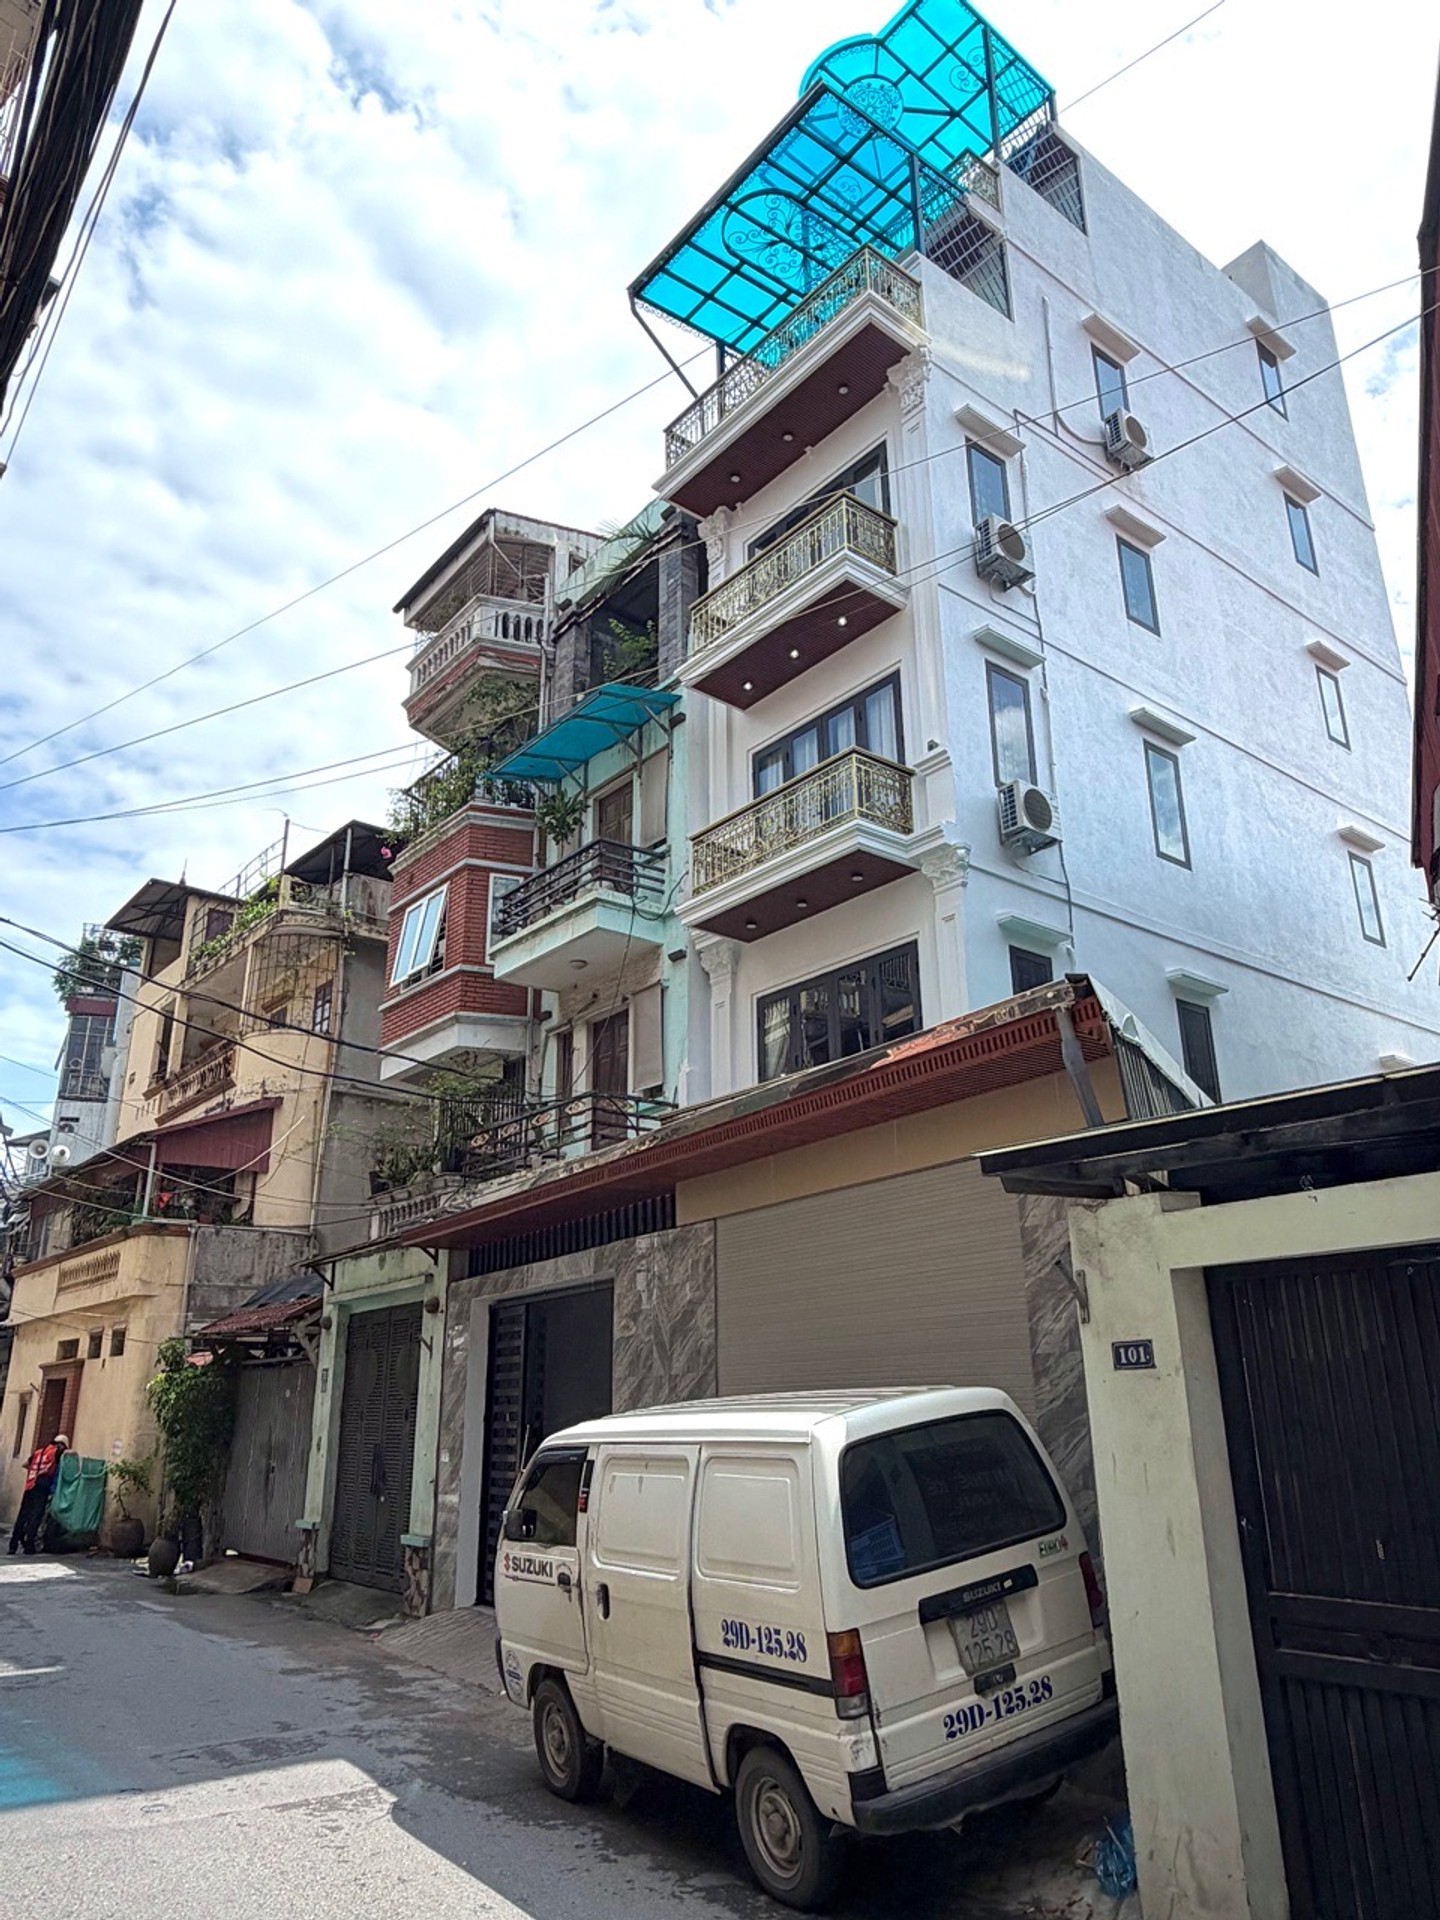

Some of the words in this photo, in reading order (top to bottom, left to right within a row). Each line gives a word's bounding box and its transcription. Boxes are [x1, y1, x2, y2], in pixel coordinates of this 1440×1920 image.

[1118, 1346, 1147, 1363] 101
[511, 1556, 553, 1578] SUZUKI
[963, 1582, 1001, 1602] SUZUKI
[721, 1618, 807, 1663] 29D-125.28
[943, 1675, 1053, 1741] 29D-125.28
